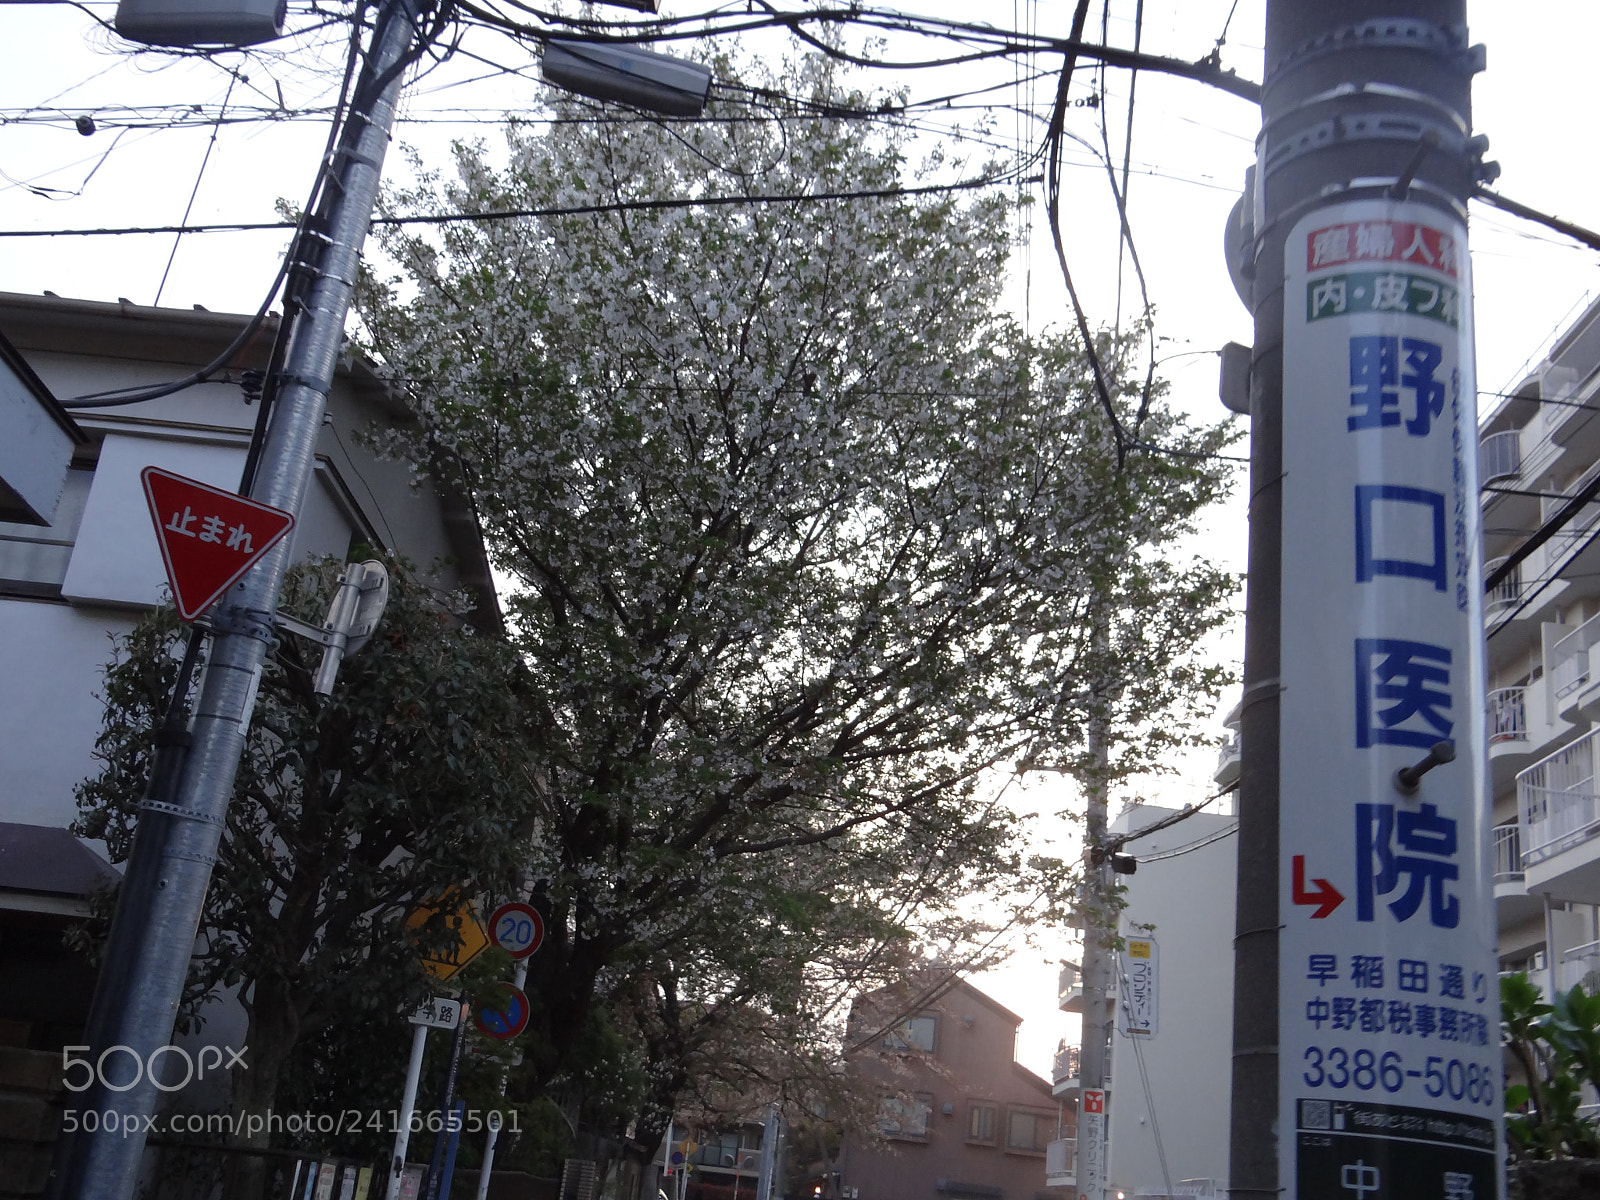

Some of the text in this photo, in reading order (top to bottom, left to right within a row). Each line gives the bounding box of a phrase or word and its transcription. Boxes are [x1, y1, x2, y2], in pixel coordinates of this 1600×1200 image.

[165, 505, 254, 554] 止まれ
[1347, 336, 1460, 929] 野口医院
[498, 917, 532, 945] 20
[1306, 954, 1488, 1003] 早稲田通り
[1303, 1046, 1495, 1106] 3386-5086
